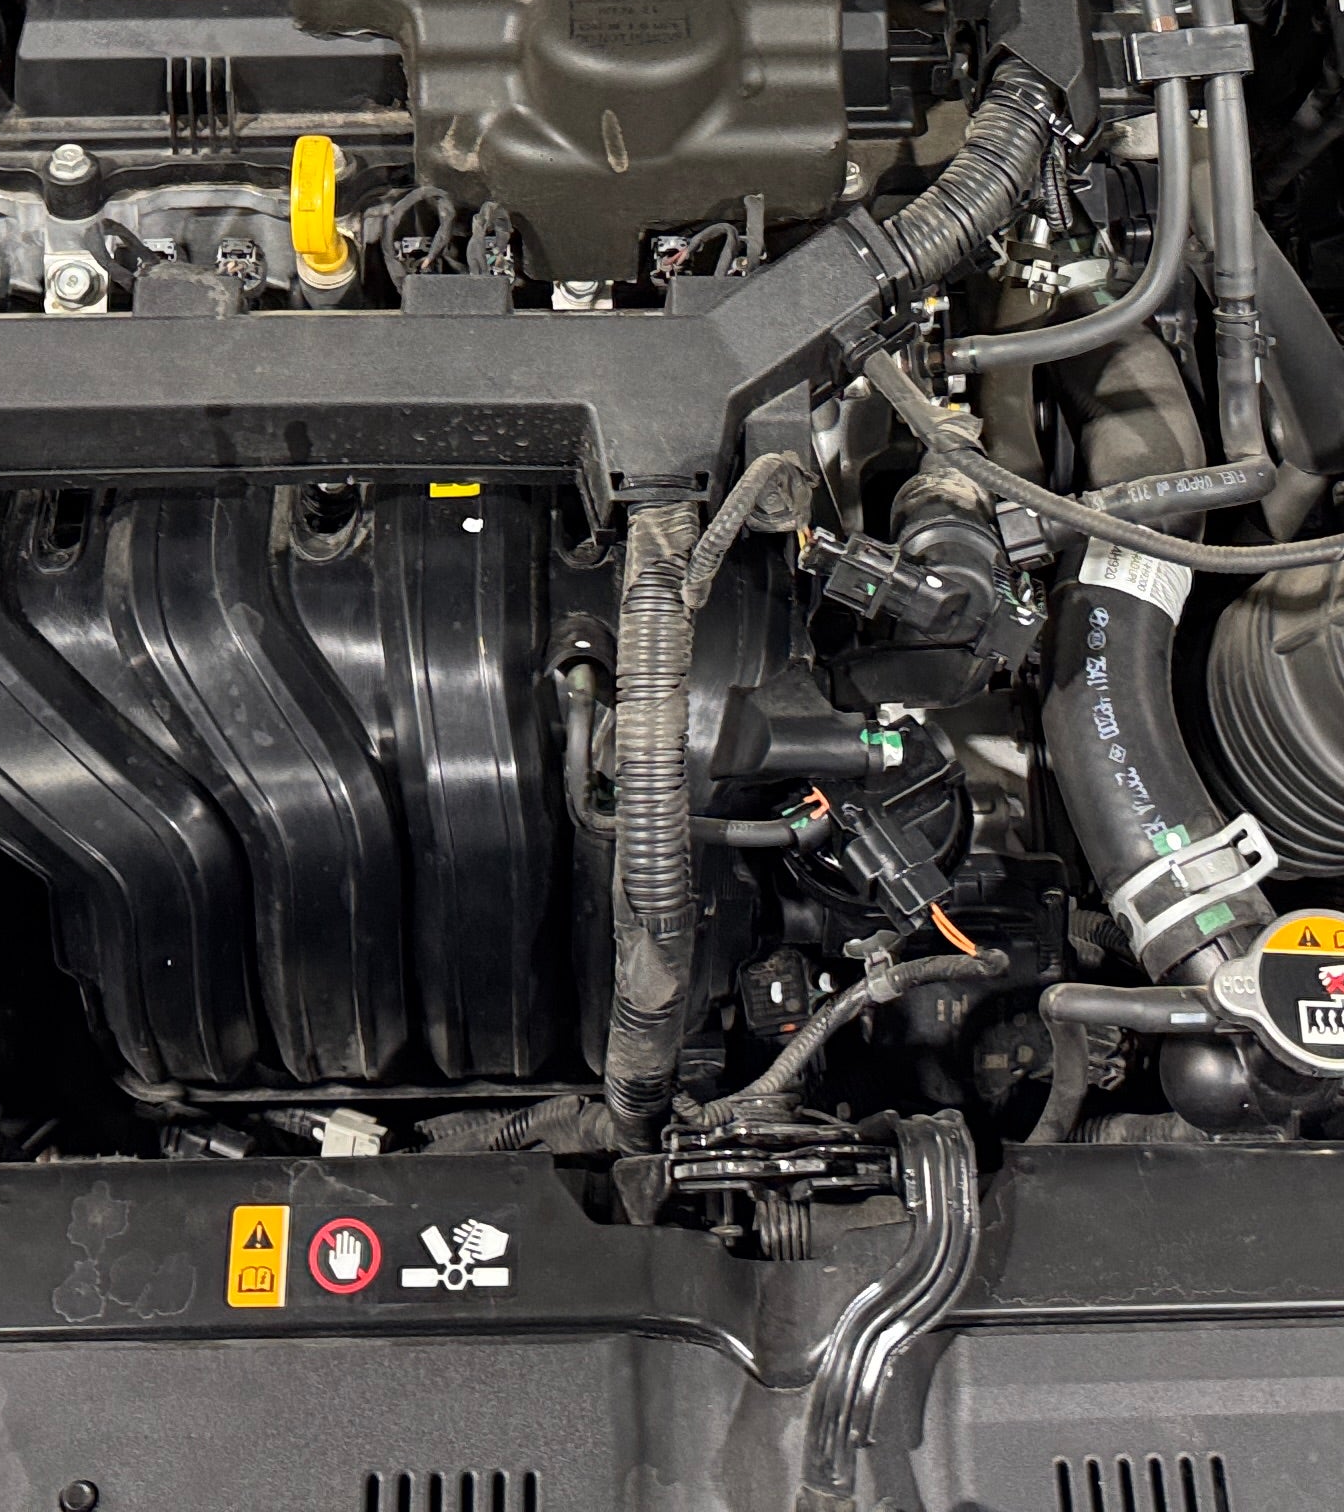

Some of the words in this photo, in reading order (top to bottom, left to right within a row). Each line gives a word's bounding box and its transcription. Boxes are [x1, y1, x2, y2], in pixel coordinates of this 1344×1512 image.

[1175, 475, 1214, 494] VAPOR
[1218, 469, 1248, 486] FUEL
[1222, 975, 1256, 996] HCC
